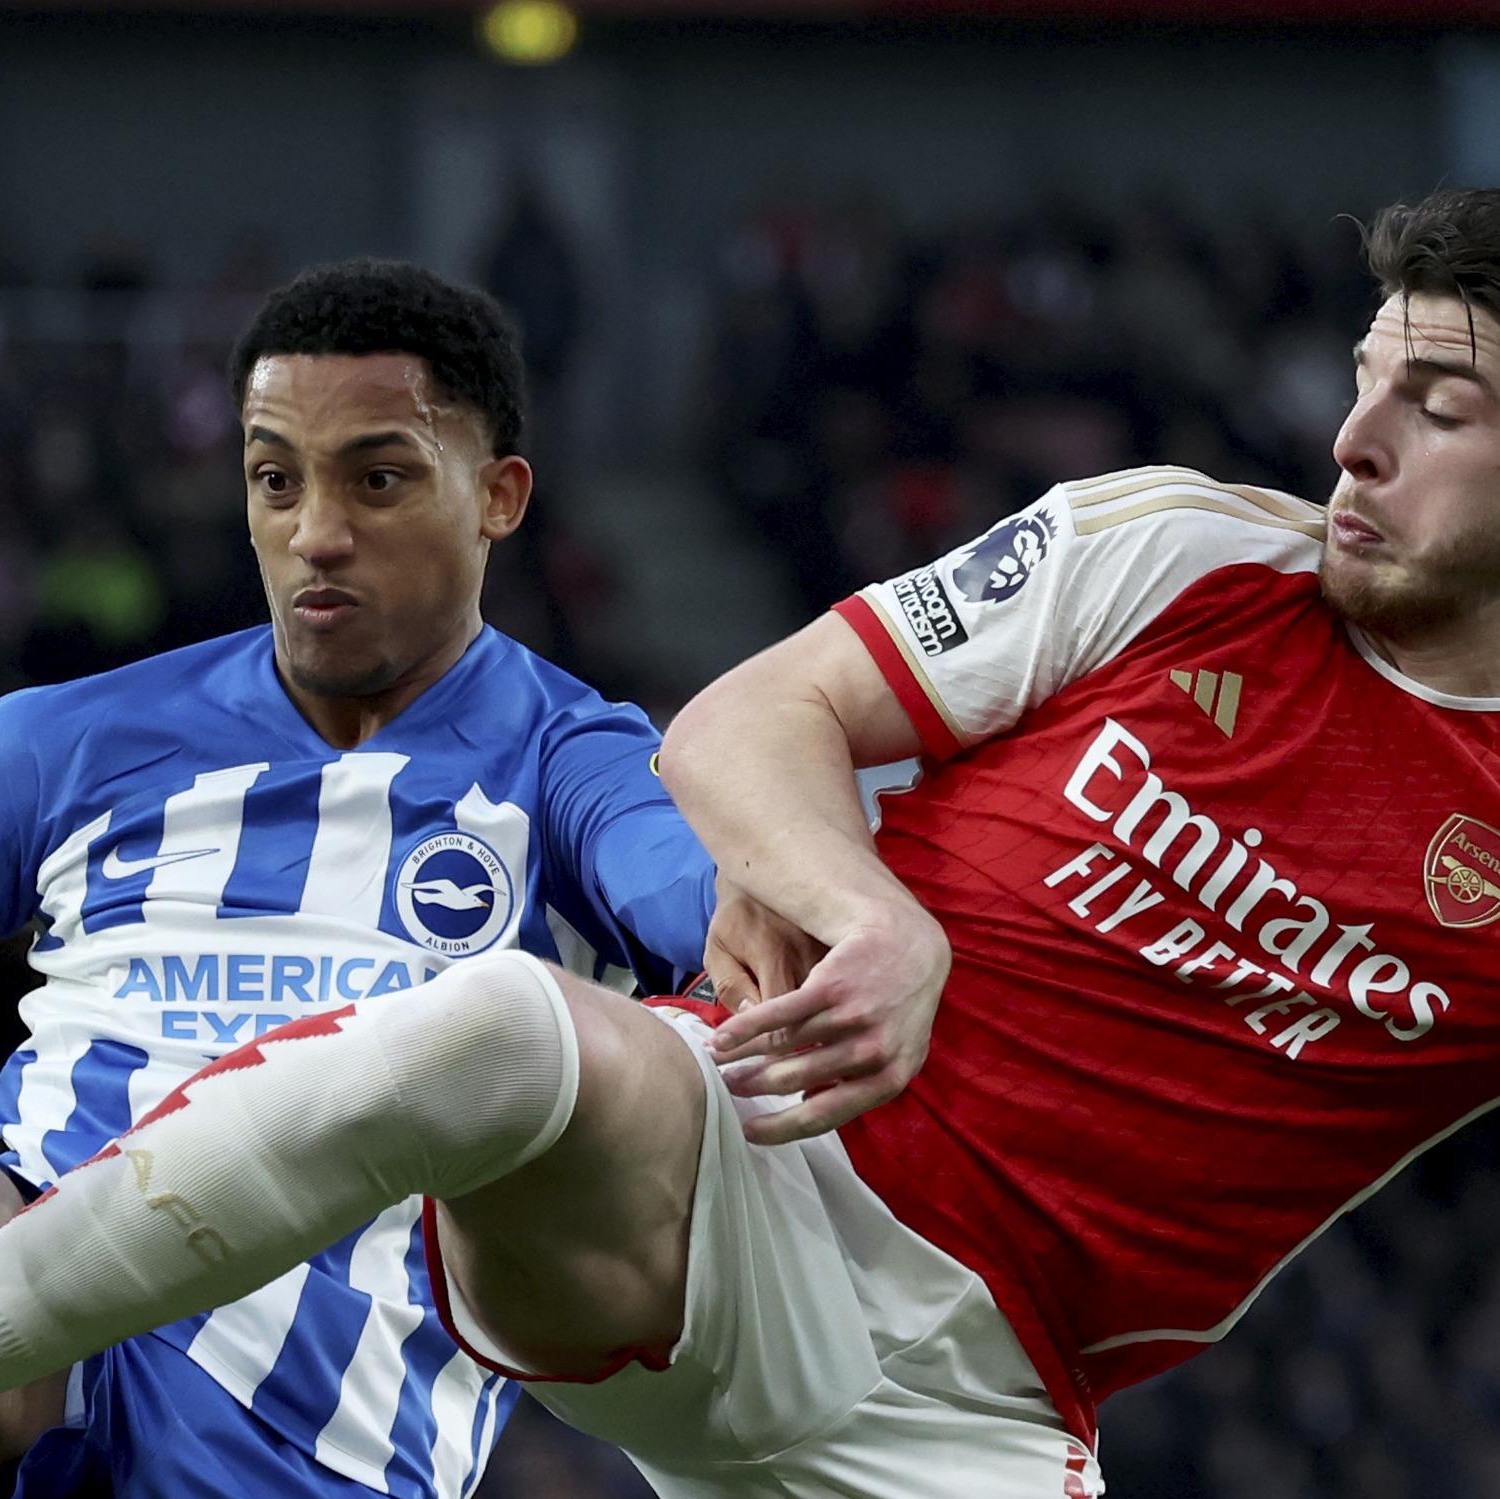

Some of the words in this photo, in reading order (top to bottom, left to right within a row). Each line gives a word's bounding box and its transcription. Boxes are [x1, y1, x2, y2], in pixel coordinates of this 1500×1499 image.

[412, 837, 462, 864] BRIGHTON
[467, 841, 475, 850] &
[477, 849, 500, 876] HOVE
[1063, 716, 1451, 1041] Emirates
[425, 936, 469, 952] ALBION
[1043, 842, 1166, 933] FLY
[1139, 917, 1342, 1061] BETTER
[114, 955, 438, 1002] AMERICA
